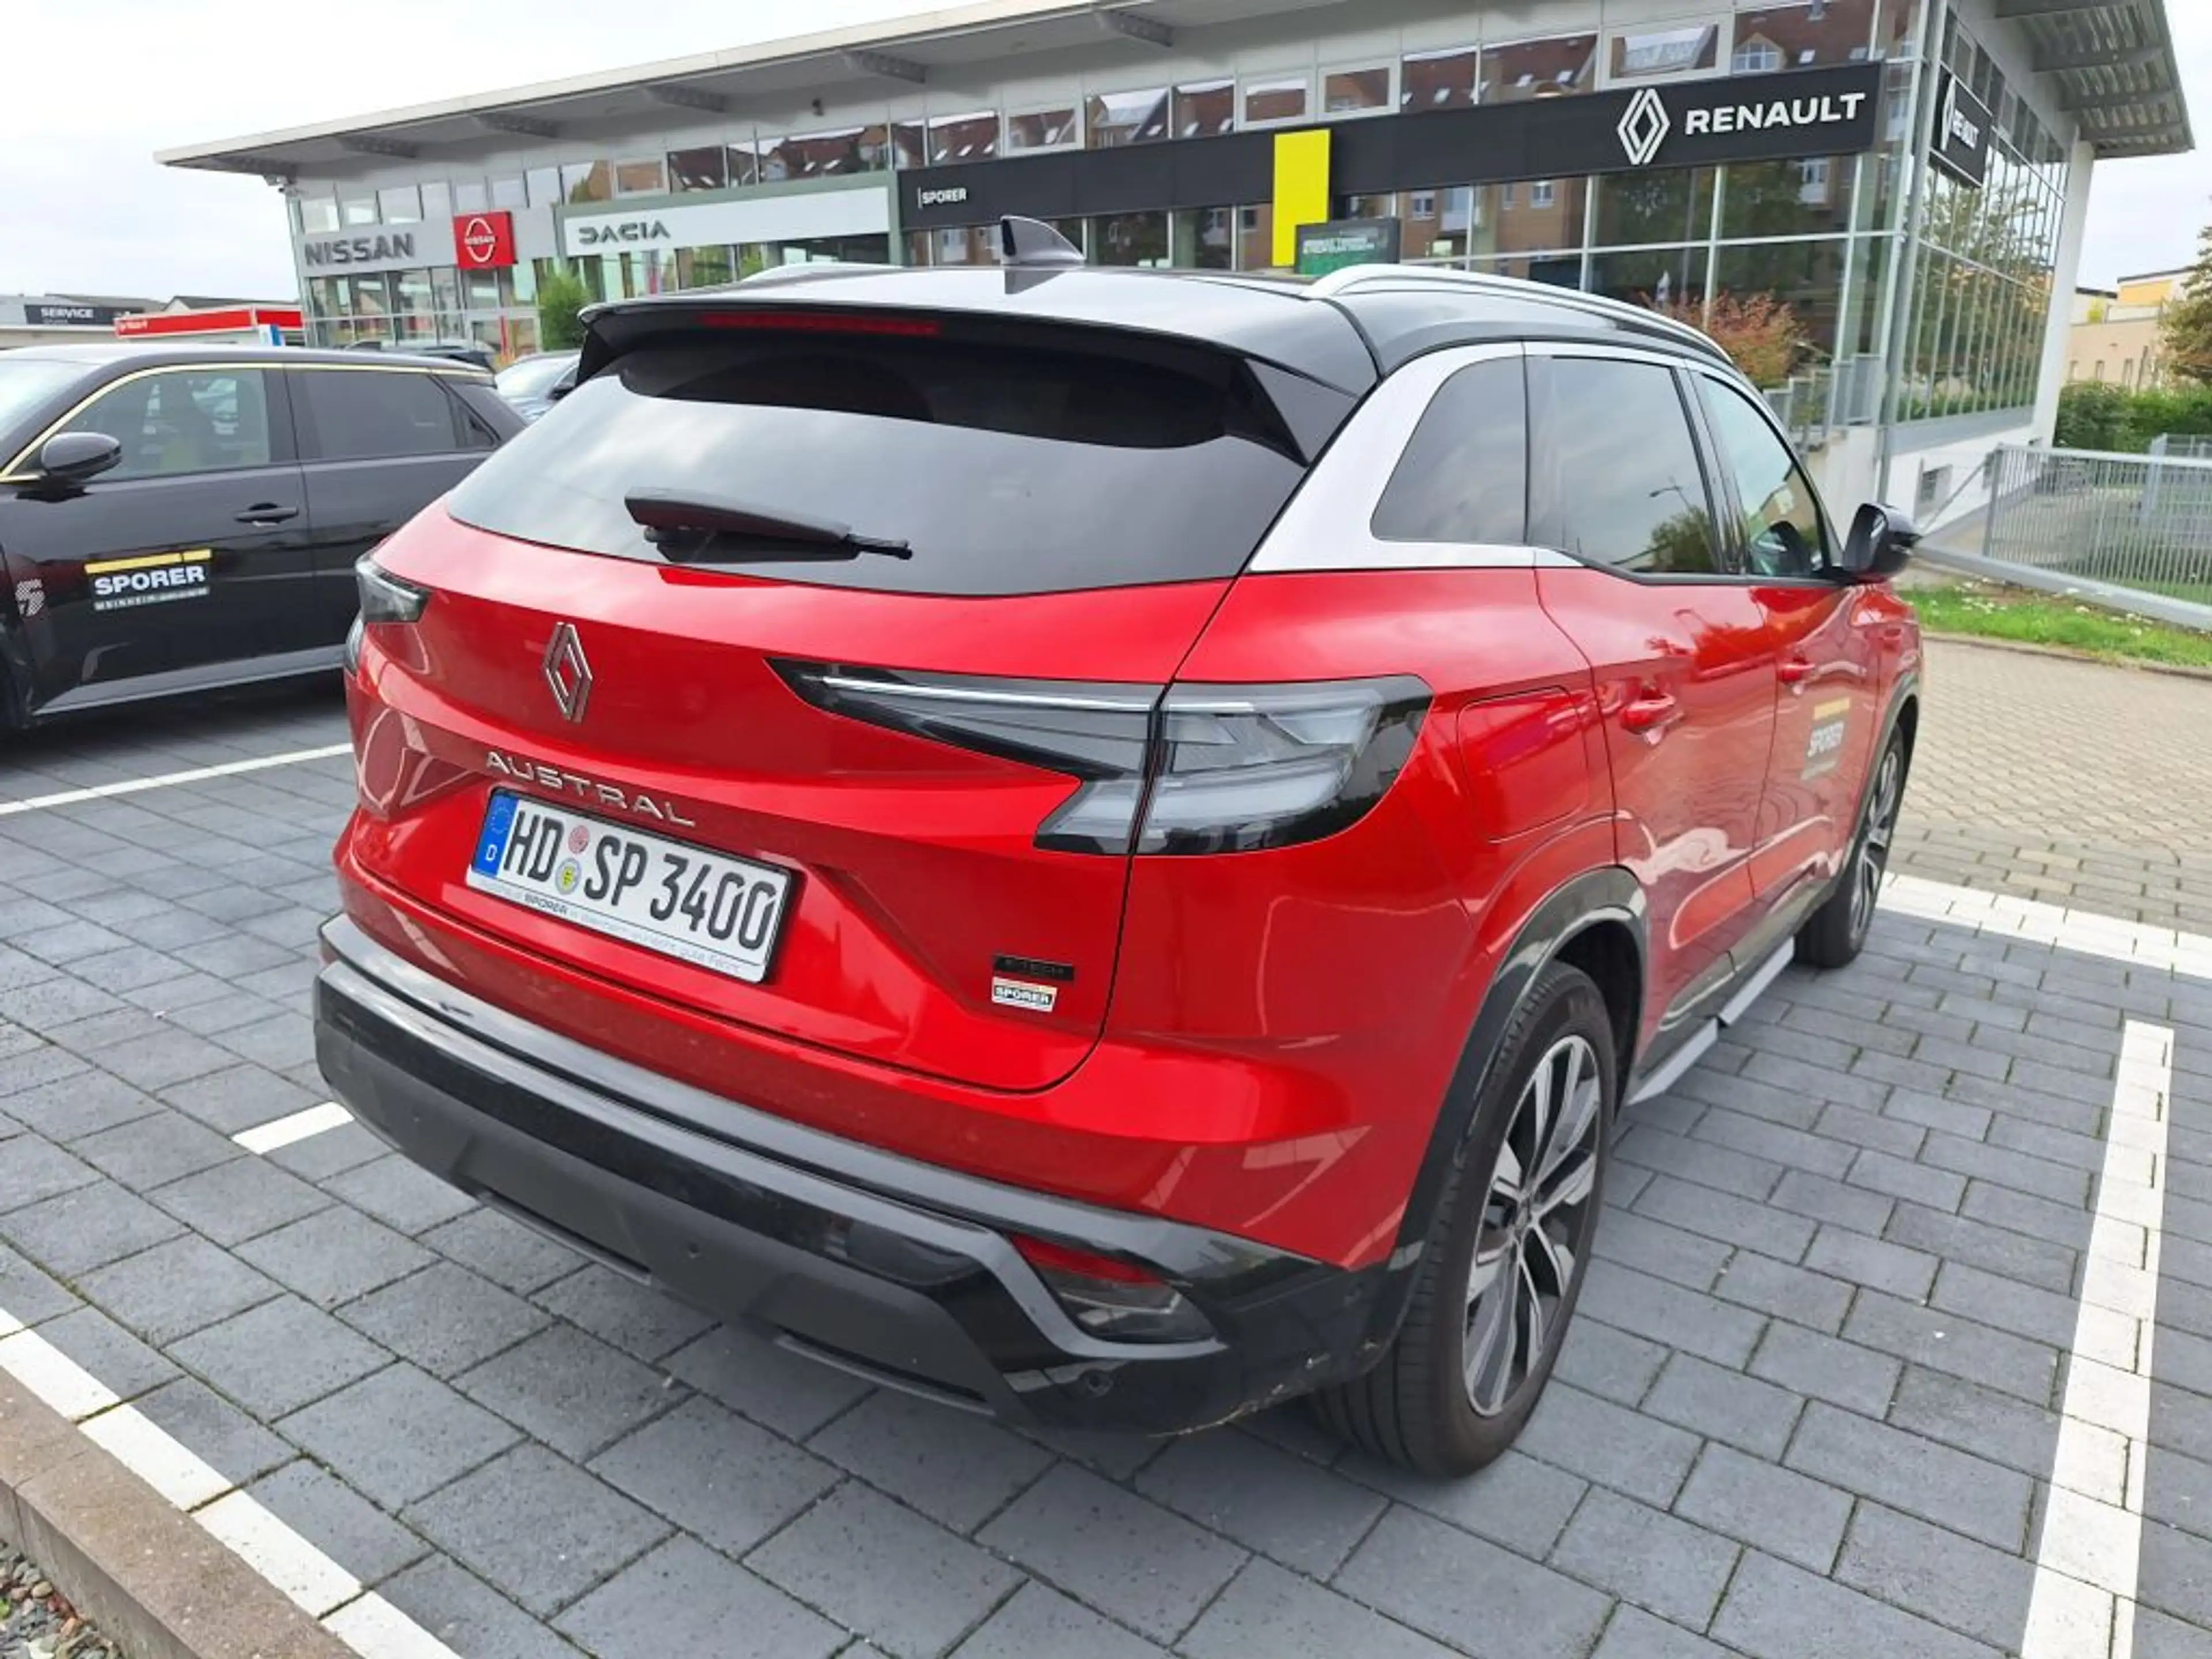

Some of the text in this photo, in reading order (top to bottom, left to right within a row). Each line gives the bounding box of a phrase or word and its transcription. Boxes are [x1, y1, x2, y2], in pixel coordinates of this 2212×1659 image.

[1684, 92, 1866, 135] RENAULT
[922, 187, 967, 204] SPORER
[578, 219, 671, 245] DACIA
[304, 232, 415, 266] NISSAN
[40, 306, 94, 319] SERVICE
[94, 565, 206, 595] SPORER
[486, 750, 696, 827] AUSTRAL
[486, 844, 498, 862] D
[503, 810, 565, 882] HD
[583, 835, 649, 906] SP
[649, 852, 778, 950] 3400
[995, 986, 1051, 1005] SPORER
